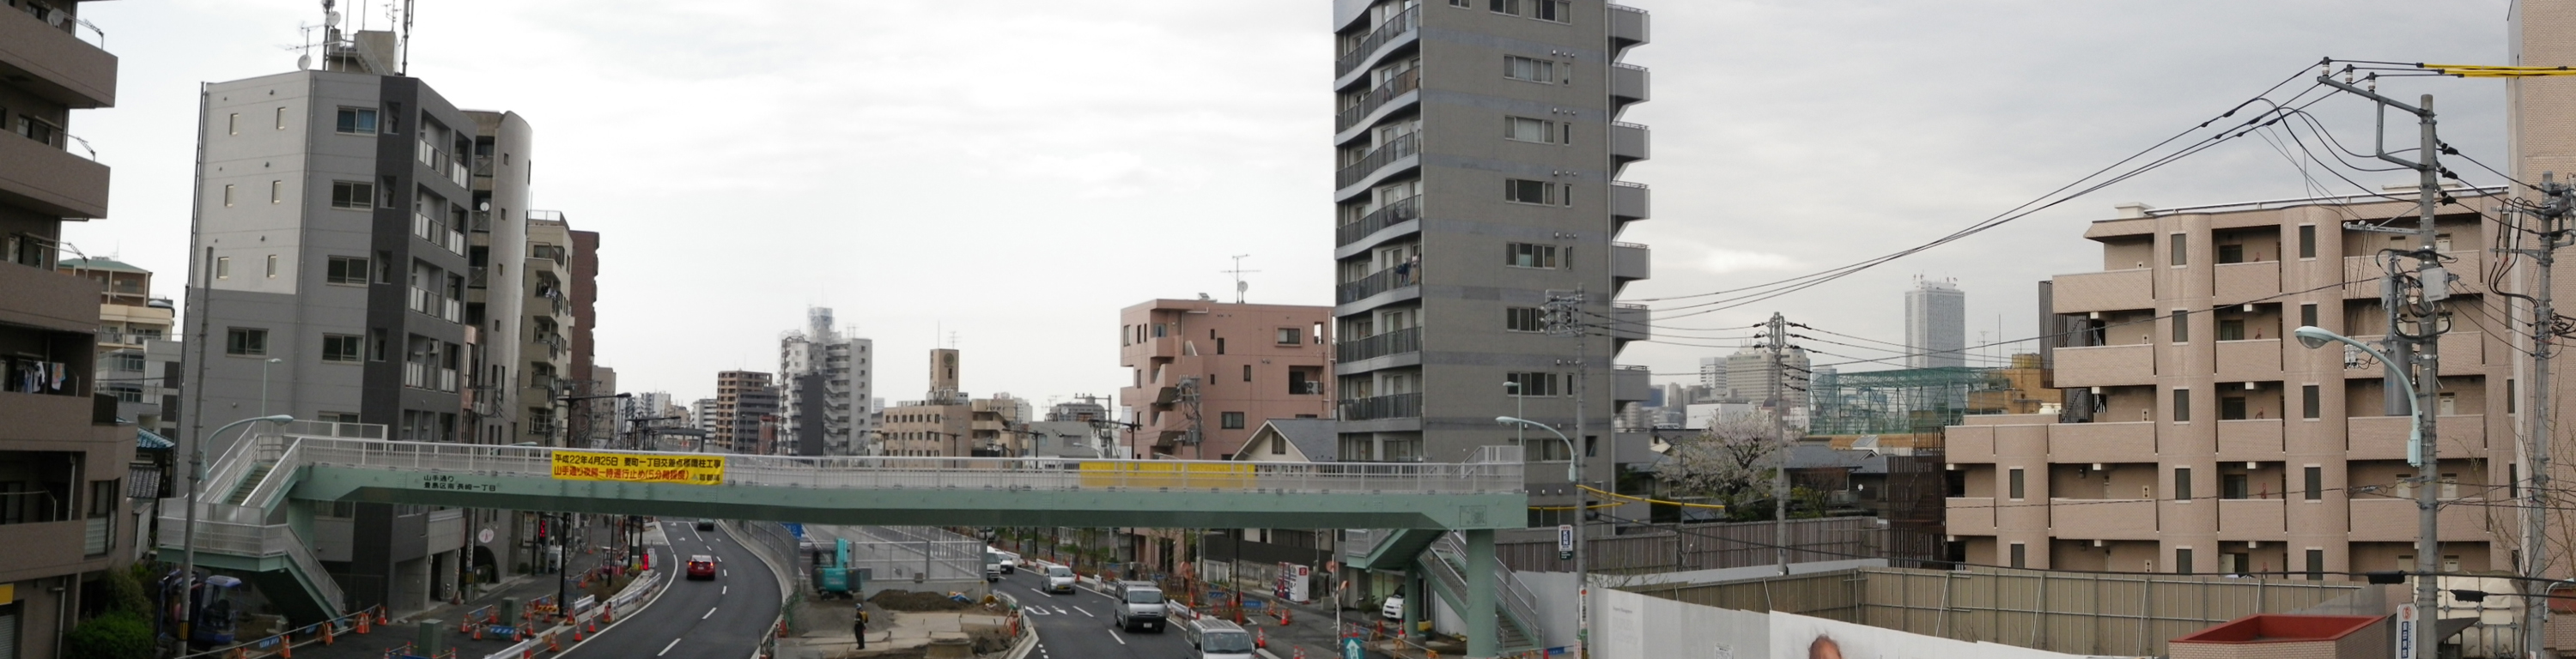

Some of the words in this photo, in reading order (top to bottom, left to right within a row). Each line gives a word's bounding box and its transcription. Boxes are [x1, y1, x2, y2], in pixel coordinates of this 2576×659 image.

[555, 454, 618, 467] 平成22年4月25日
[423, 474, 454, 482] 山手通り
